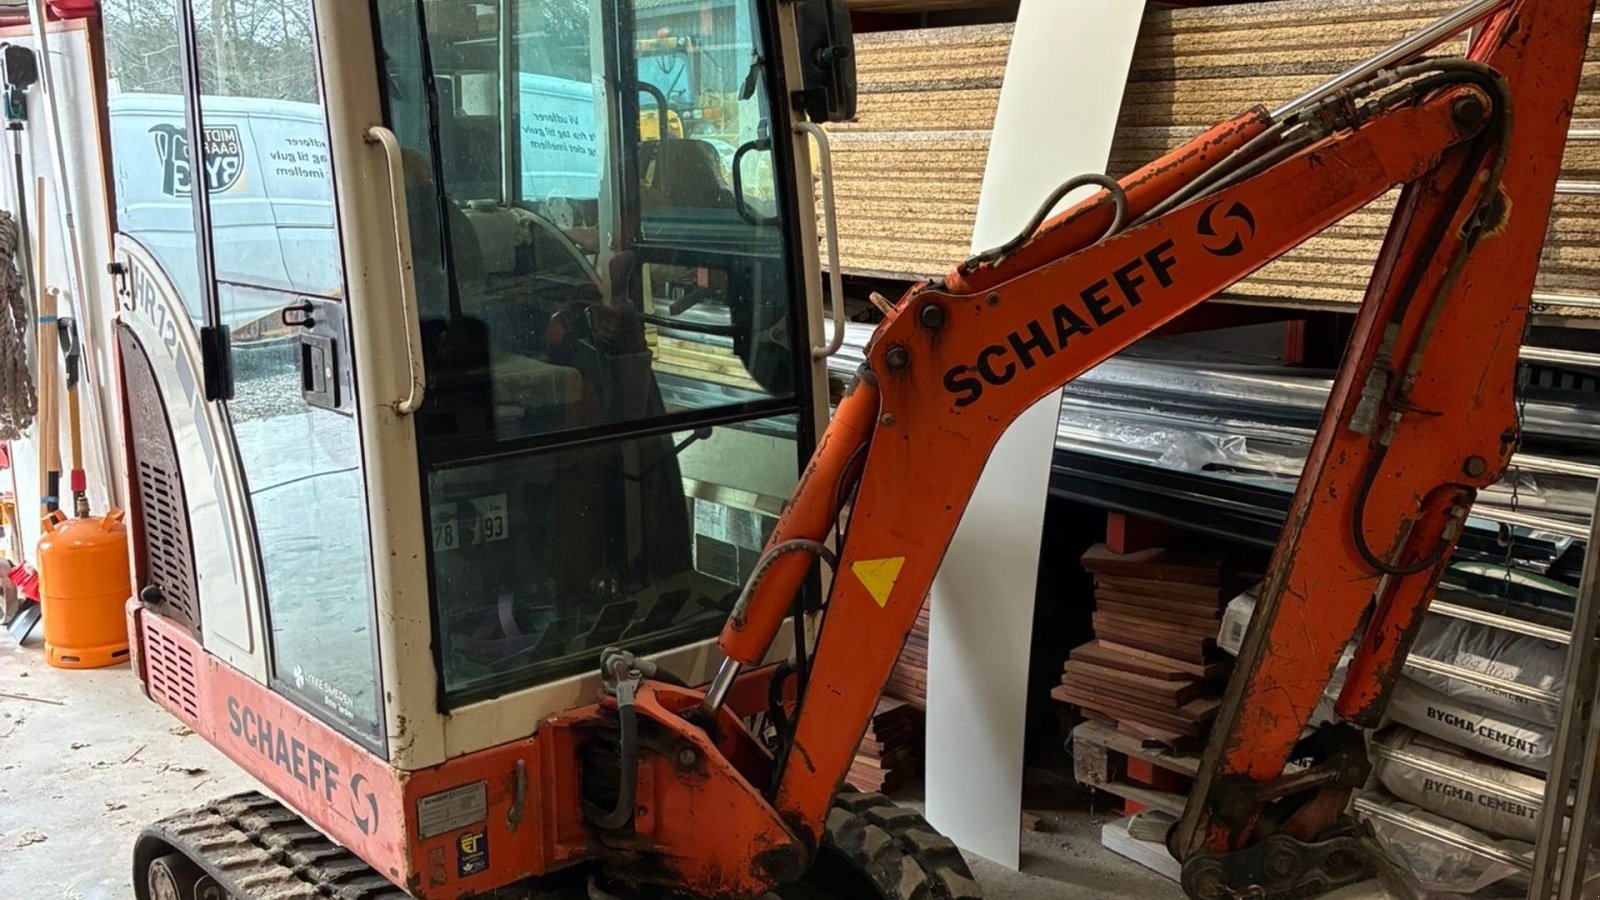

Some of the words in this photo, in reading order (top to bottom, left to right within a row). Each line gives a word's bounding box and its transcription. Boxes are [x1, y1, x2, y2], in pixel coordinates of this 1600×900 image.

[134, 264, 176, 360] HR12
[943, 238, 1178, 407] SCHAEFF
[227, 695, 340, 803] SCHAEFF
[1427, 706, 1475, 734] BYGMA
[1479, 725, 1538, 755] CEMENT
[1424, 778, 1474, 803] BYGMA
[1478, 794, 1539, 820] CEMENT
